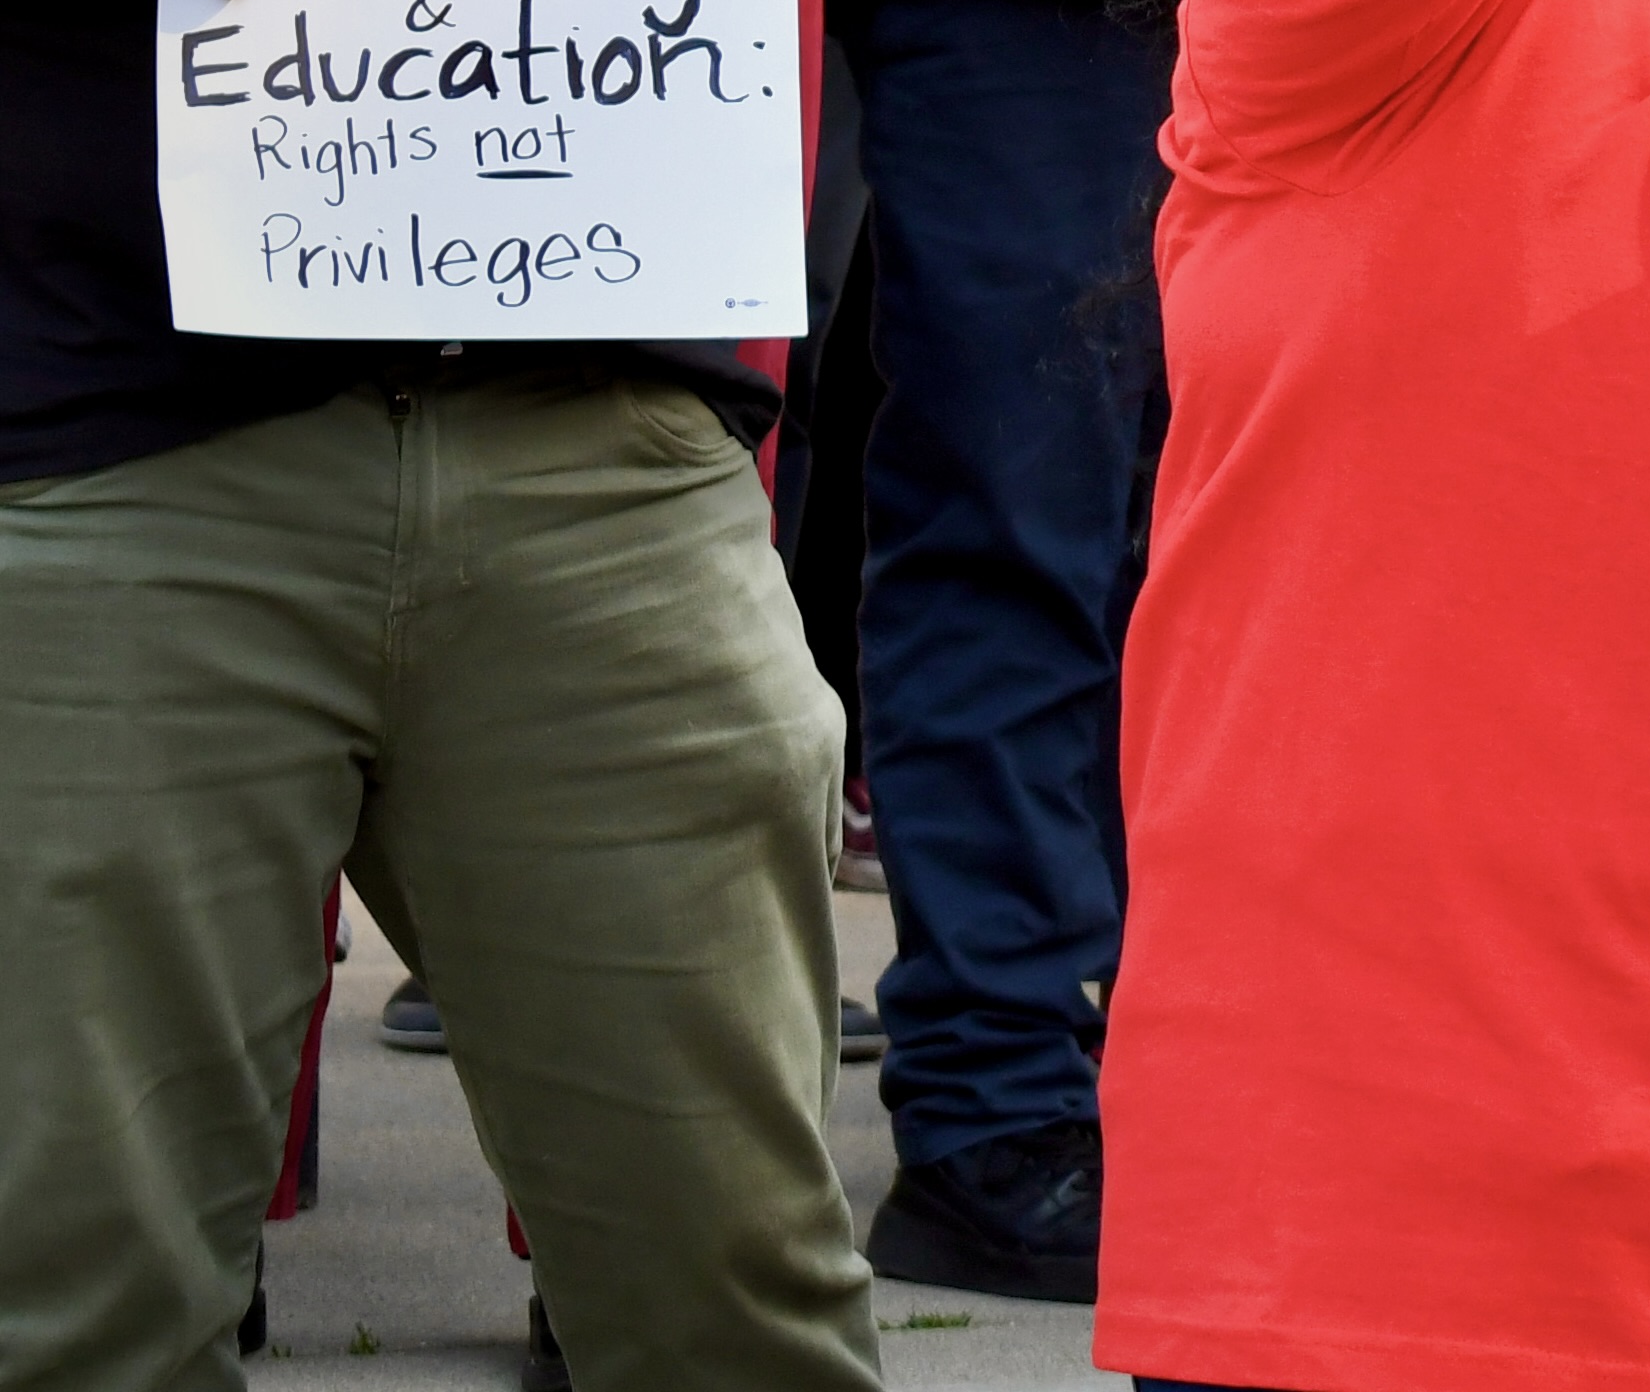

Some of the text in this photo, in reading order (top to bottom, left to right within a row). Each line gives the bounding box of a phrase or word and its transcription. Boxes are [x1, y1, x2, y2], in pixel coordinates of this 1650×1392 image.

[251, 113, 577, 208] Rights not
[259, 212, 642, 308] Privileges
